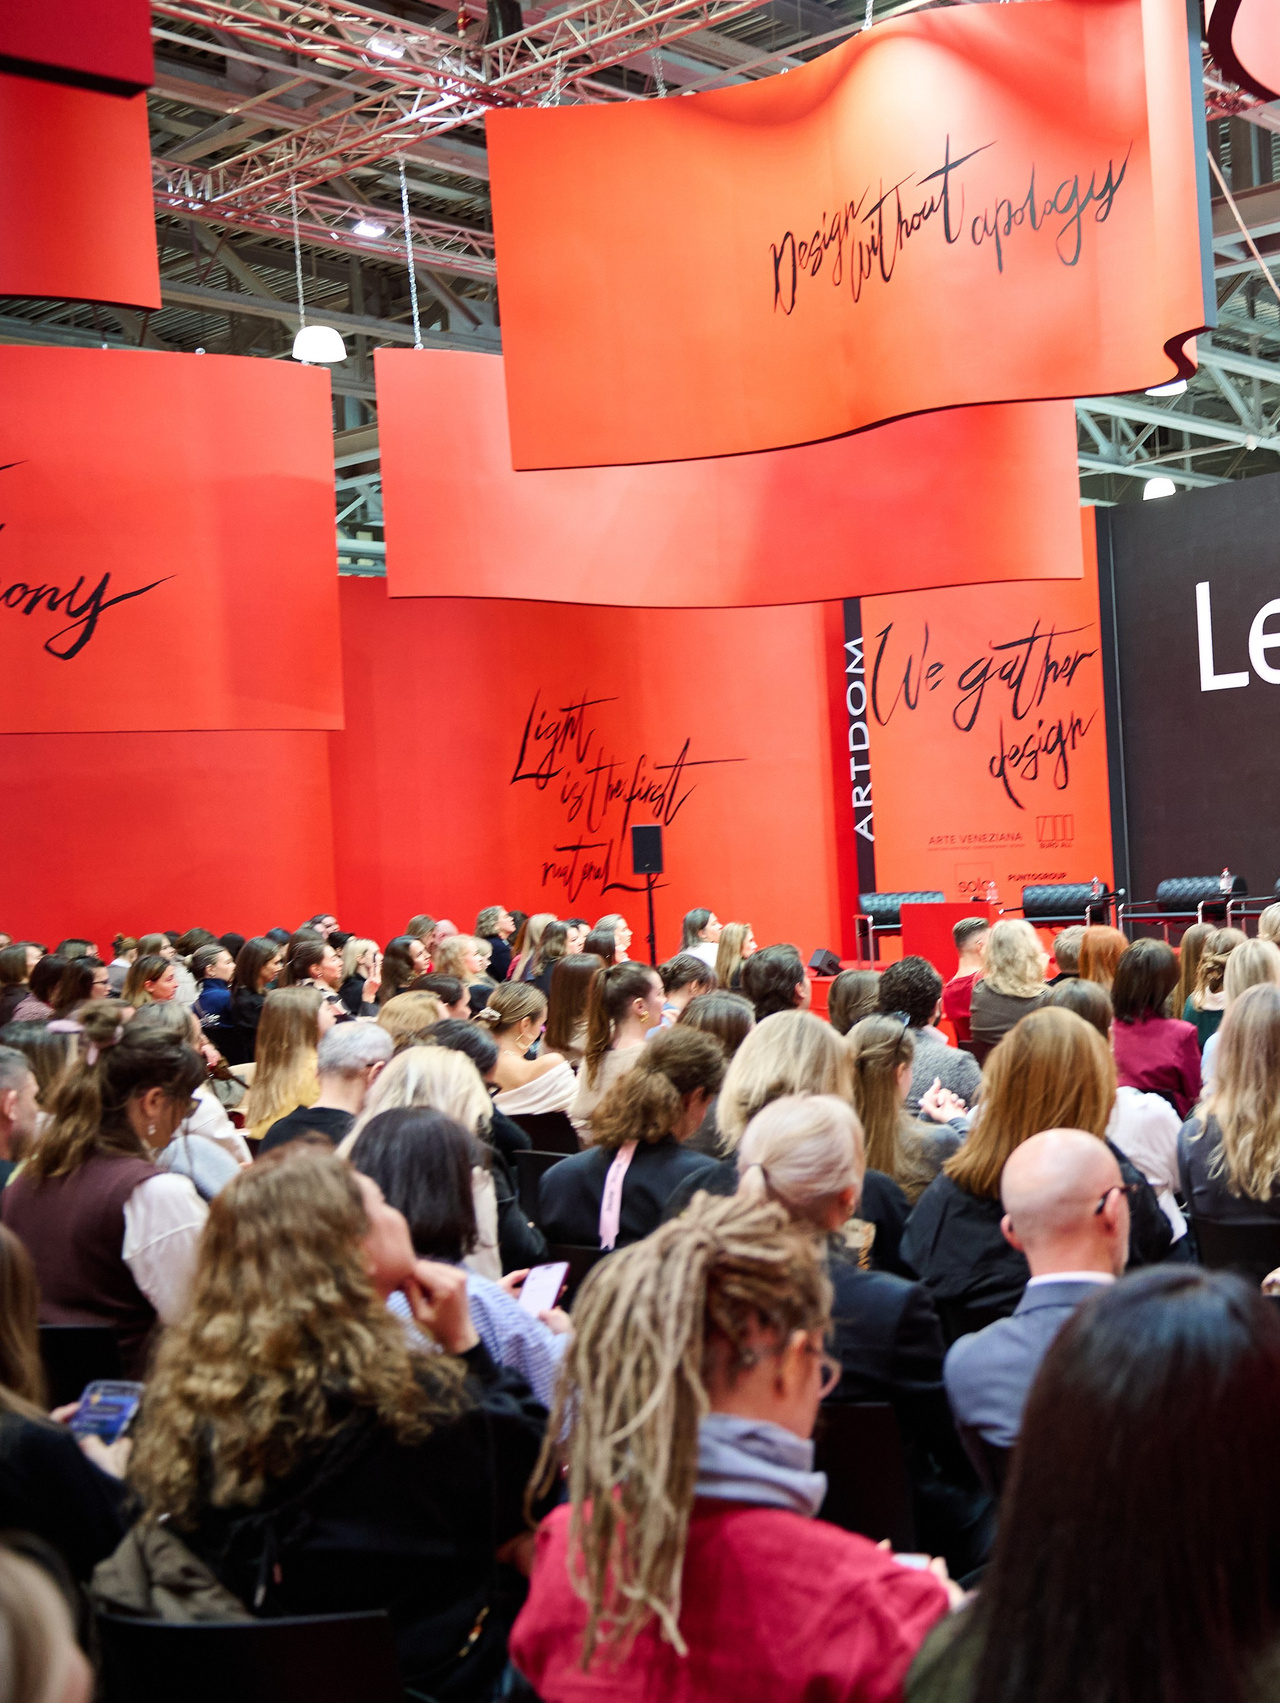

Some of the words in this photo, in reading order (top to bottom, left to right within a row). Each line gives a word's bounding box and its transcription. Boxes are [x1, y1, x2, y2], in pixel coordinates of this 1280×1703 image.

[770, 185, 870, 315] Design
[852, 134, 998, 303] without
[971, 139, 1134, 274] apology
[871, 619, 946, 727] We
[952, 617, 1099, 732] gather
[510, 687, 621, 790] Light
[843, 636, 876, 843] ARTDOM
[988, 706, 1100, 811] design
[560, 770, 588, 823] is
[585, 746, 628, 833] the
[614, 736, 752, 868] first
[928, 835, 957, 845] ARTE
[961, 832, 1023, 843] VENEZIANA
